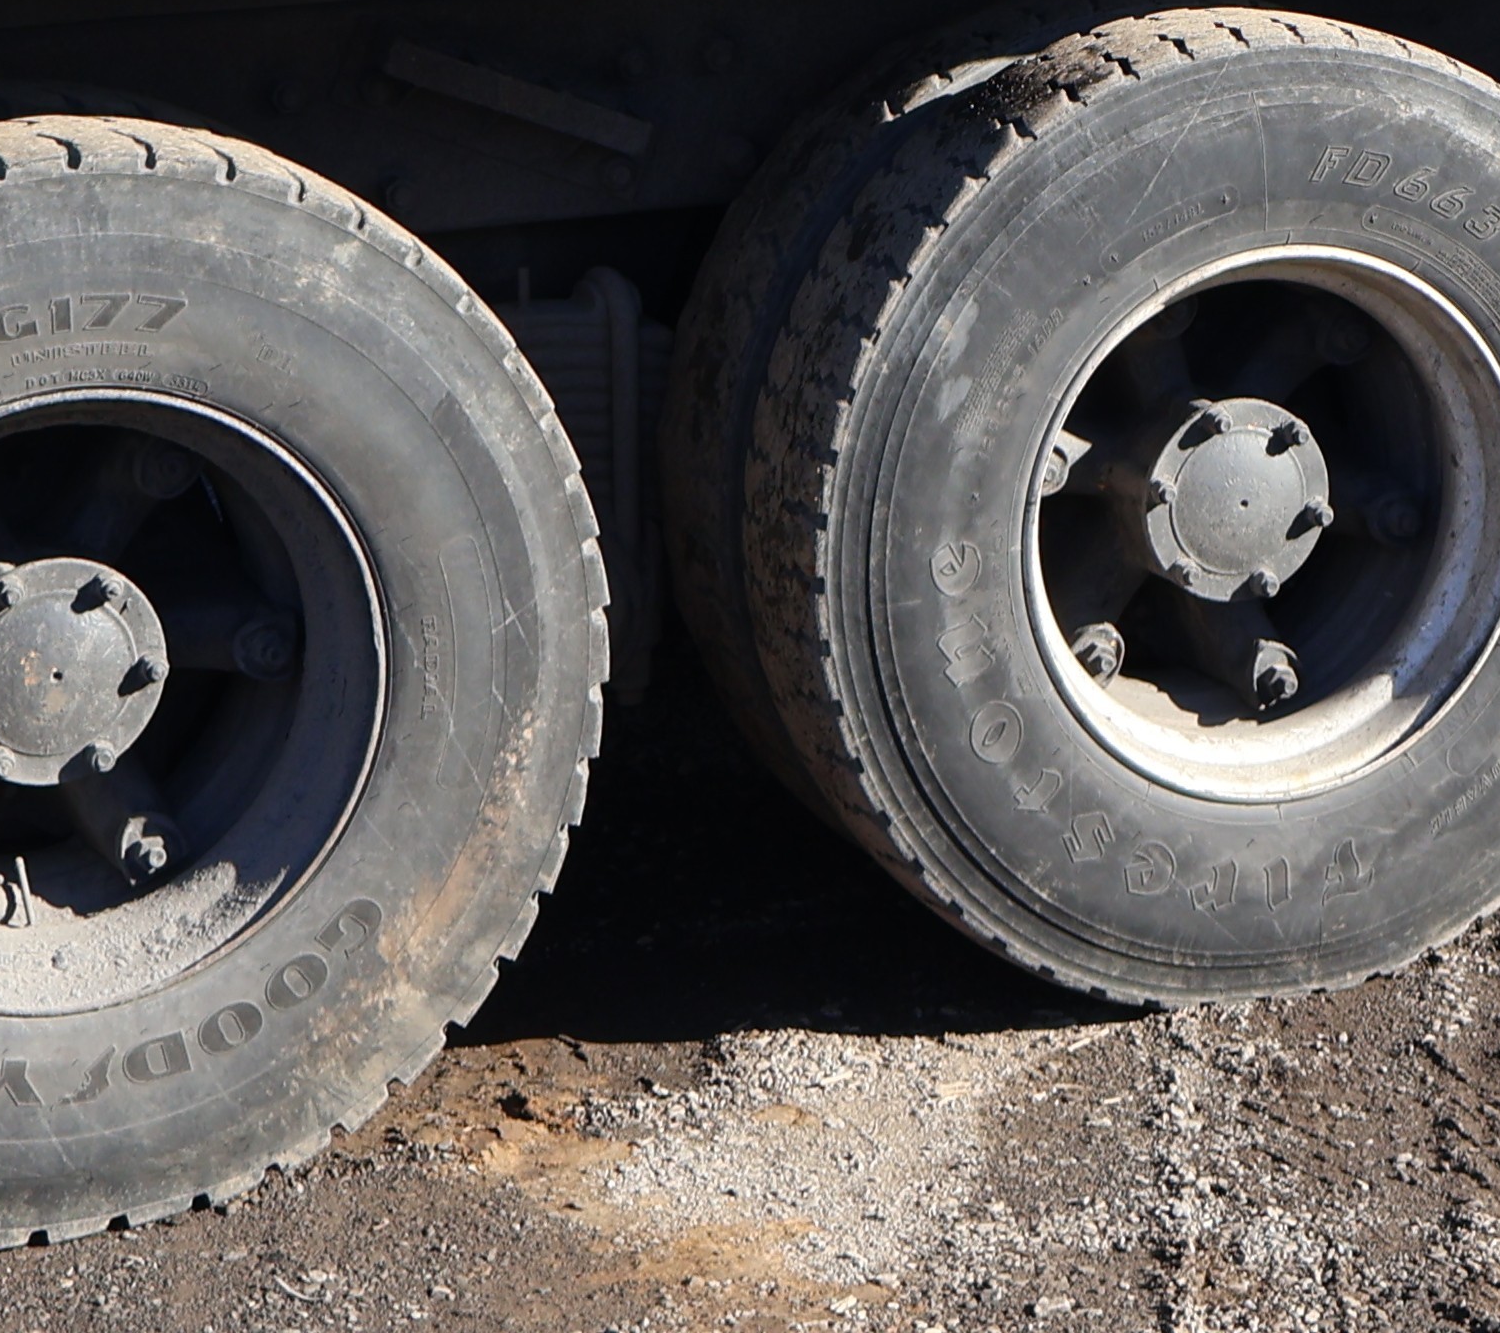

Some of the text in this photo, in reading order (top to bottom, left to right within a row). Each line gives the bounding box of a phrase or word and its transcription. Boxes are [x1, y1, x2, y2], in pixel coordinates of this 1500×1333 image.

[10, 341, 155, 367] UNISTEEL
[24, 372, 61, 390] DOT
[418, 613, 438, 720] RADIAL
[928, 540, 1381, 915] Firestone
